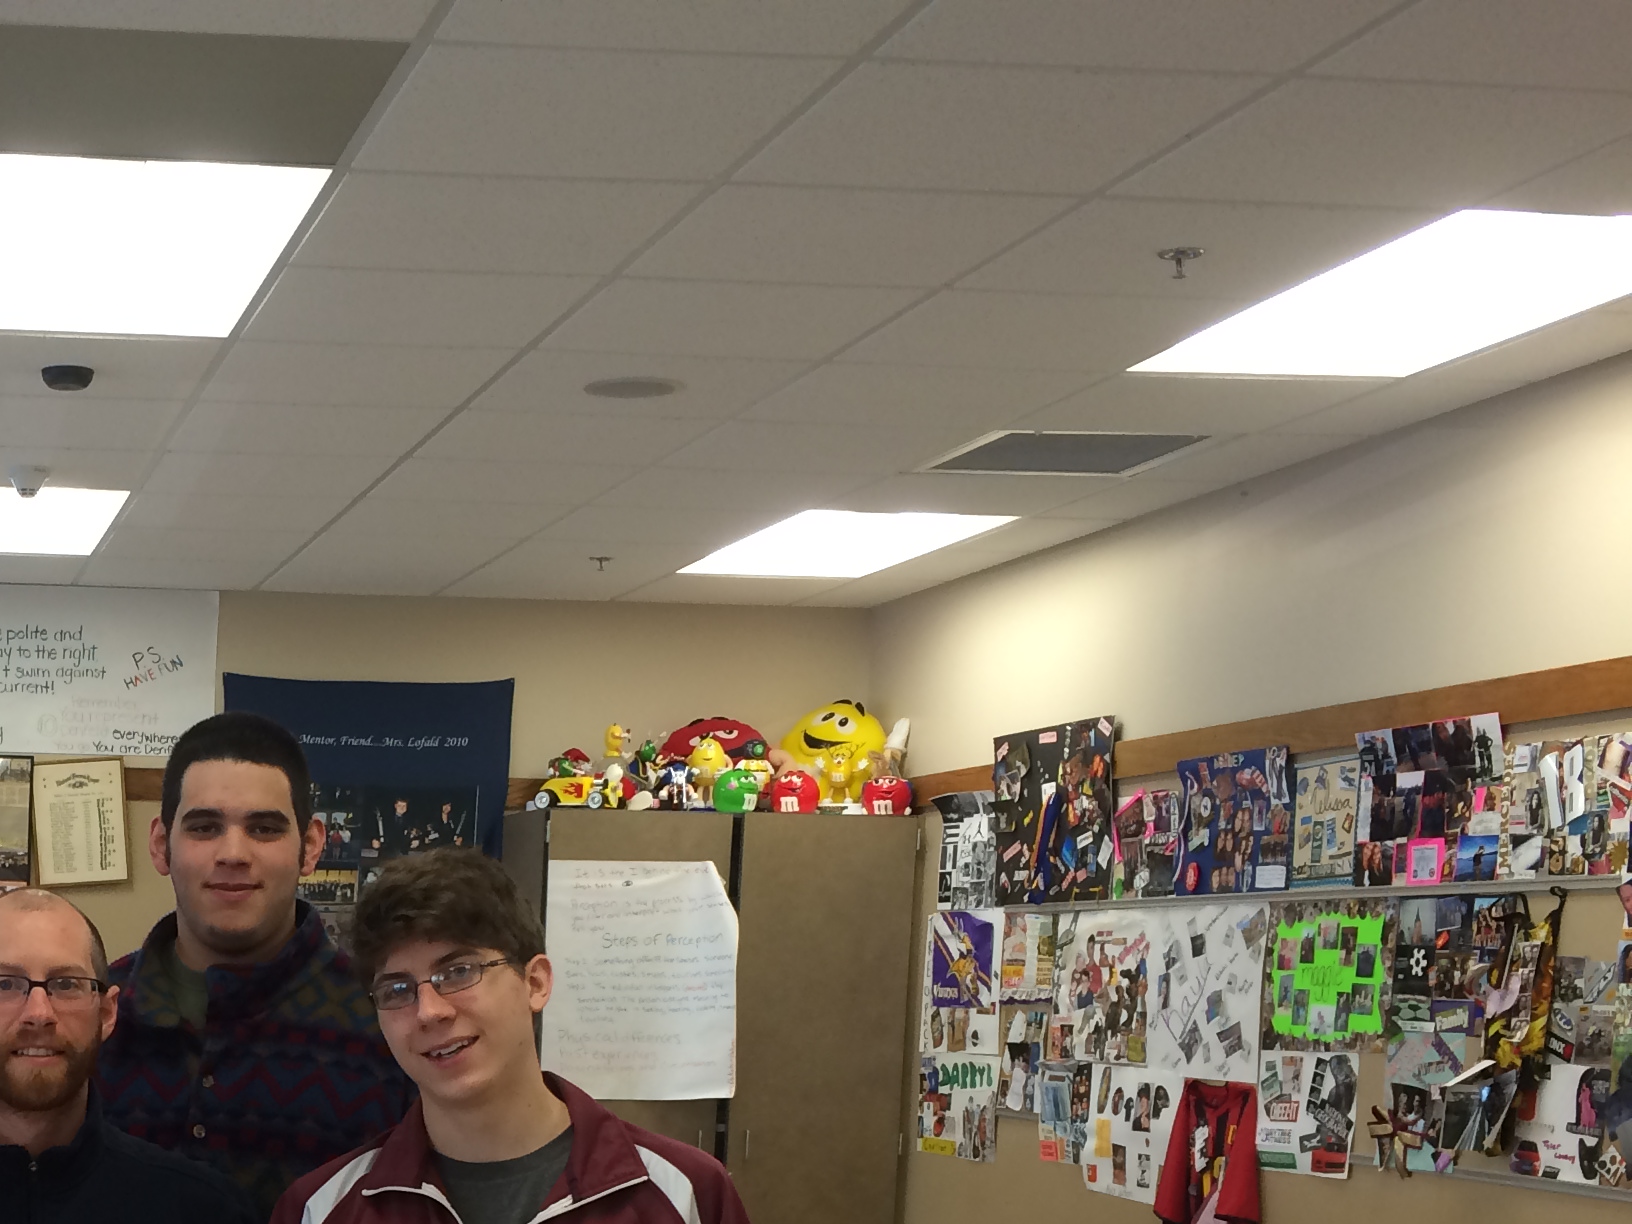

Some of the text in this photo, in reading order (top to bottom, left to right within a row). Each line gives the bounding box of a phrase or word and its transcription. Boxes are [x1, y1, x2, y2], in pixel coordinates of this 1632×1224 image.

[6, 624, 49, 645] polite
[53, 625, 84, 642] and
[16, 646, 32, 660] to
[34, 645, 57, 660] the
[15, 666, 51, 679] swim
[55, 665, 107, 684] against
[123, 654, 184, 690] HAVE FUN
[298, 733, 337, 747] Mentor,
[407, 736, 441, 751] Lofald
[444, 737, 469, 747] 2010
[601, 932, 724, 949] Steps of Perception
